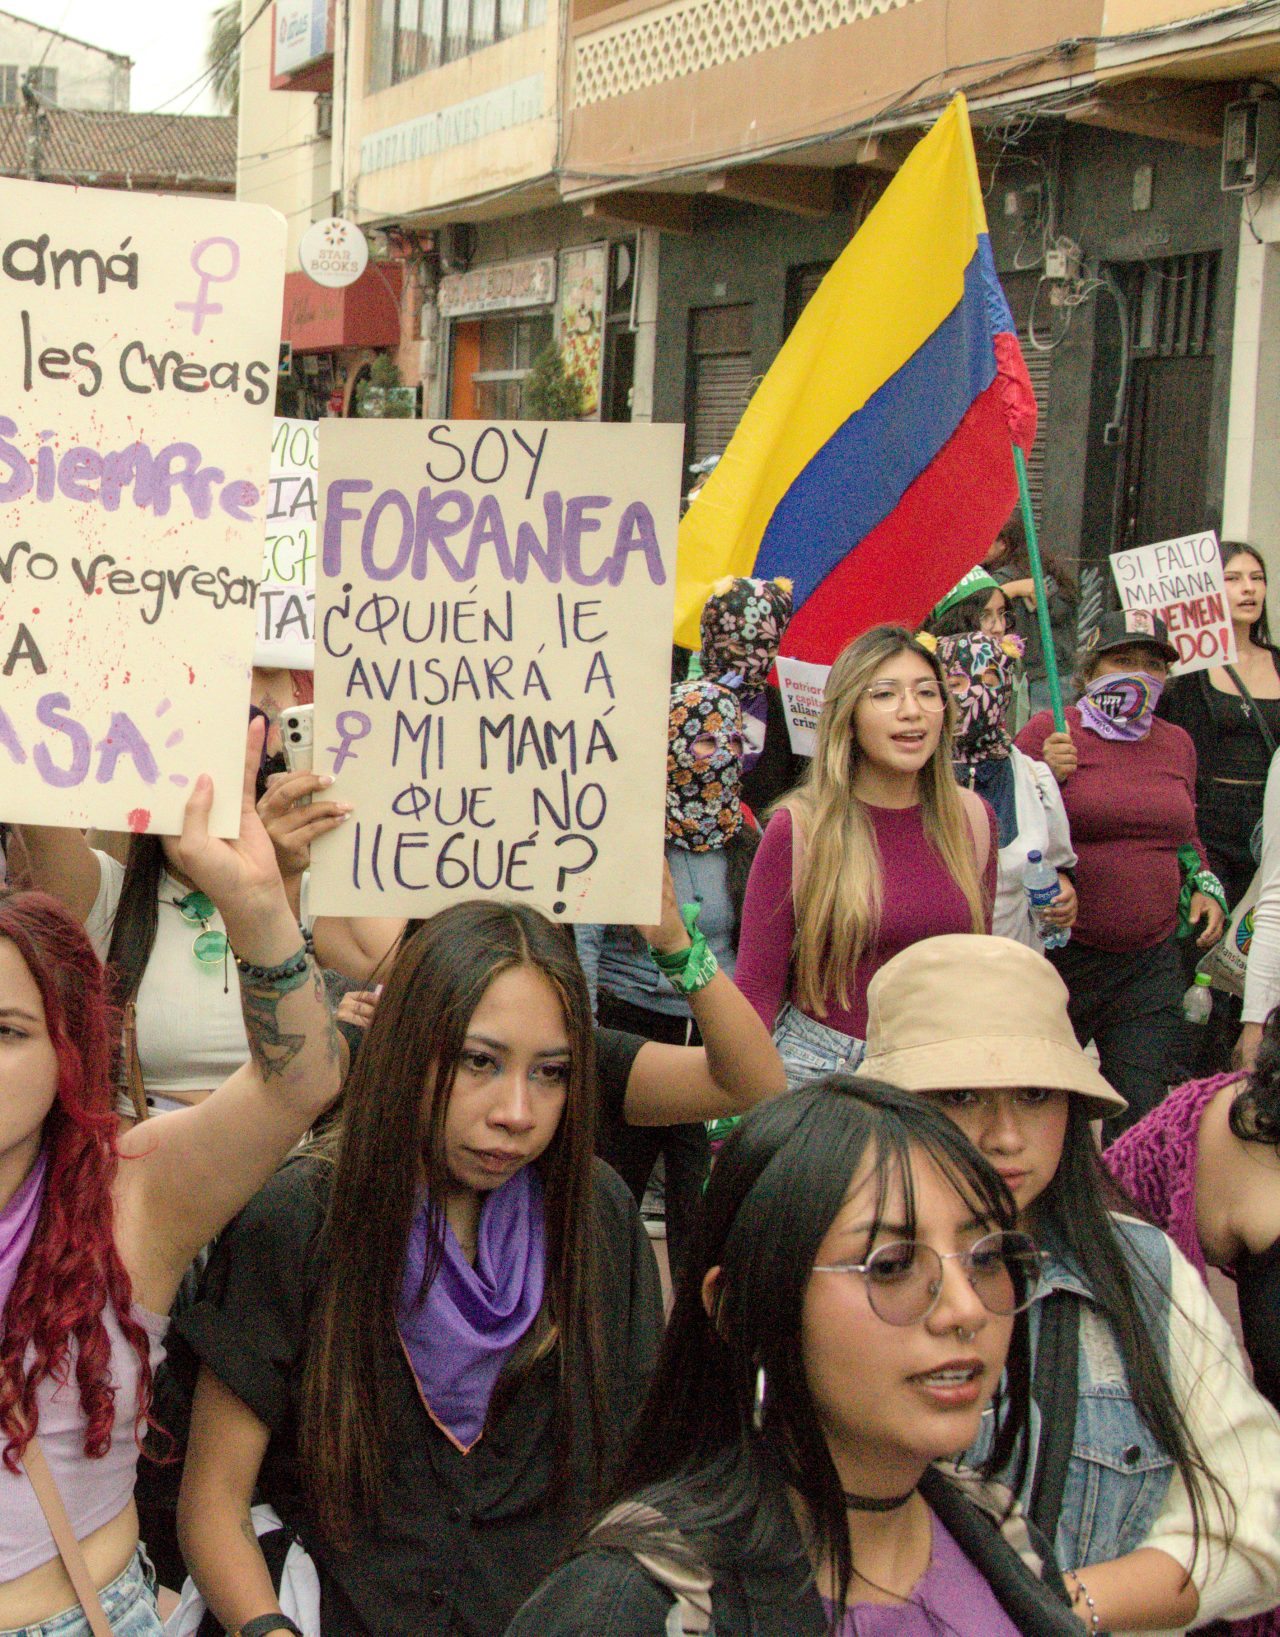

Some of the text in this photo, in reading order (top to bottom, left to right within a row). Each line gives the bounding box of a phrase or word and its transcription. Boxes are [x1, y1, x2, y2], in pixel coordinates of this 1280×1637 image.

[311, 260, 358, 273] BOOKS
[319, 249, 350, 260] STAR
[21, 310, 103, 396] les
[426, 424, 548, 499] SOY
[322, 479, 667, 587] FORANEA
[1117, 537, 1217, 581] SI FALTO
[72, 553, 262, 625] regresar
[323, 582, 513, 658] ¿QUIÉN
[1125, 571, 1216, 608] MAÑANA
[2, 622, 48, 677] A
[346, 643, 615, 706] AVISARÁ A
[790, 702, 820, 716] alian
[392, 704, 619, 780] MI MAMÁ
[391, 768, 608, 831] QUE NO
